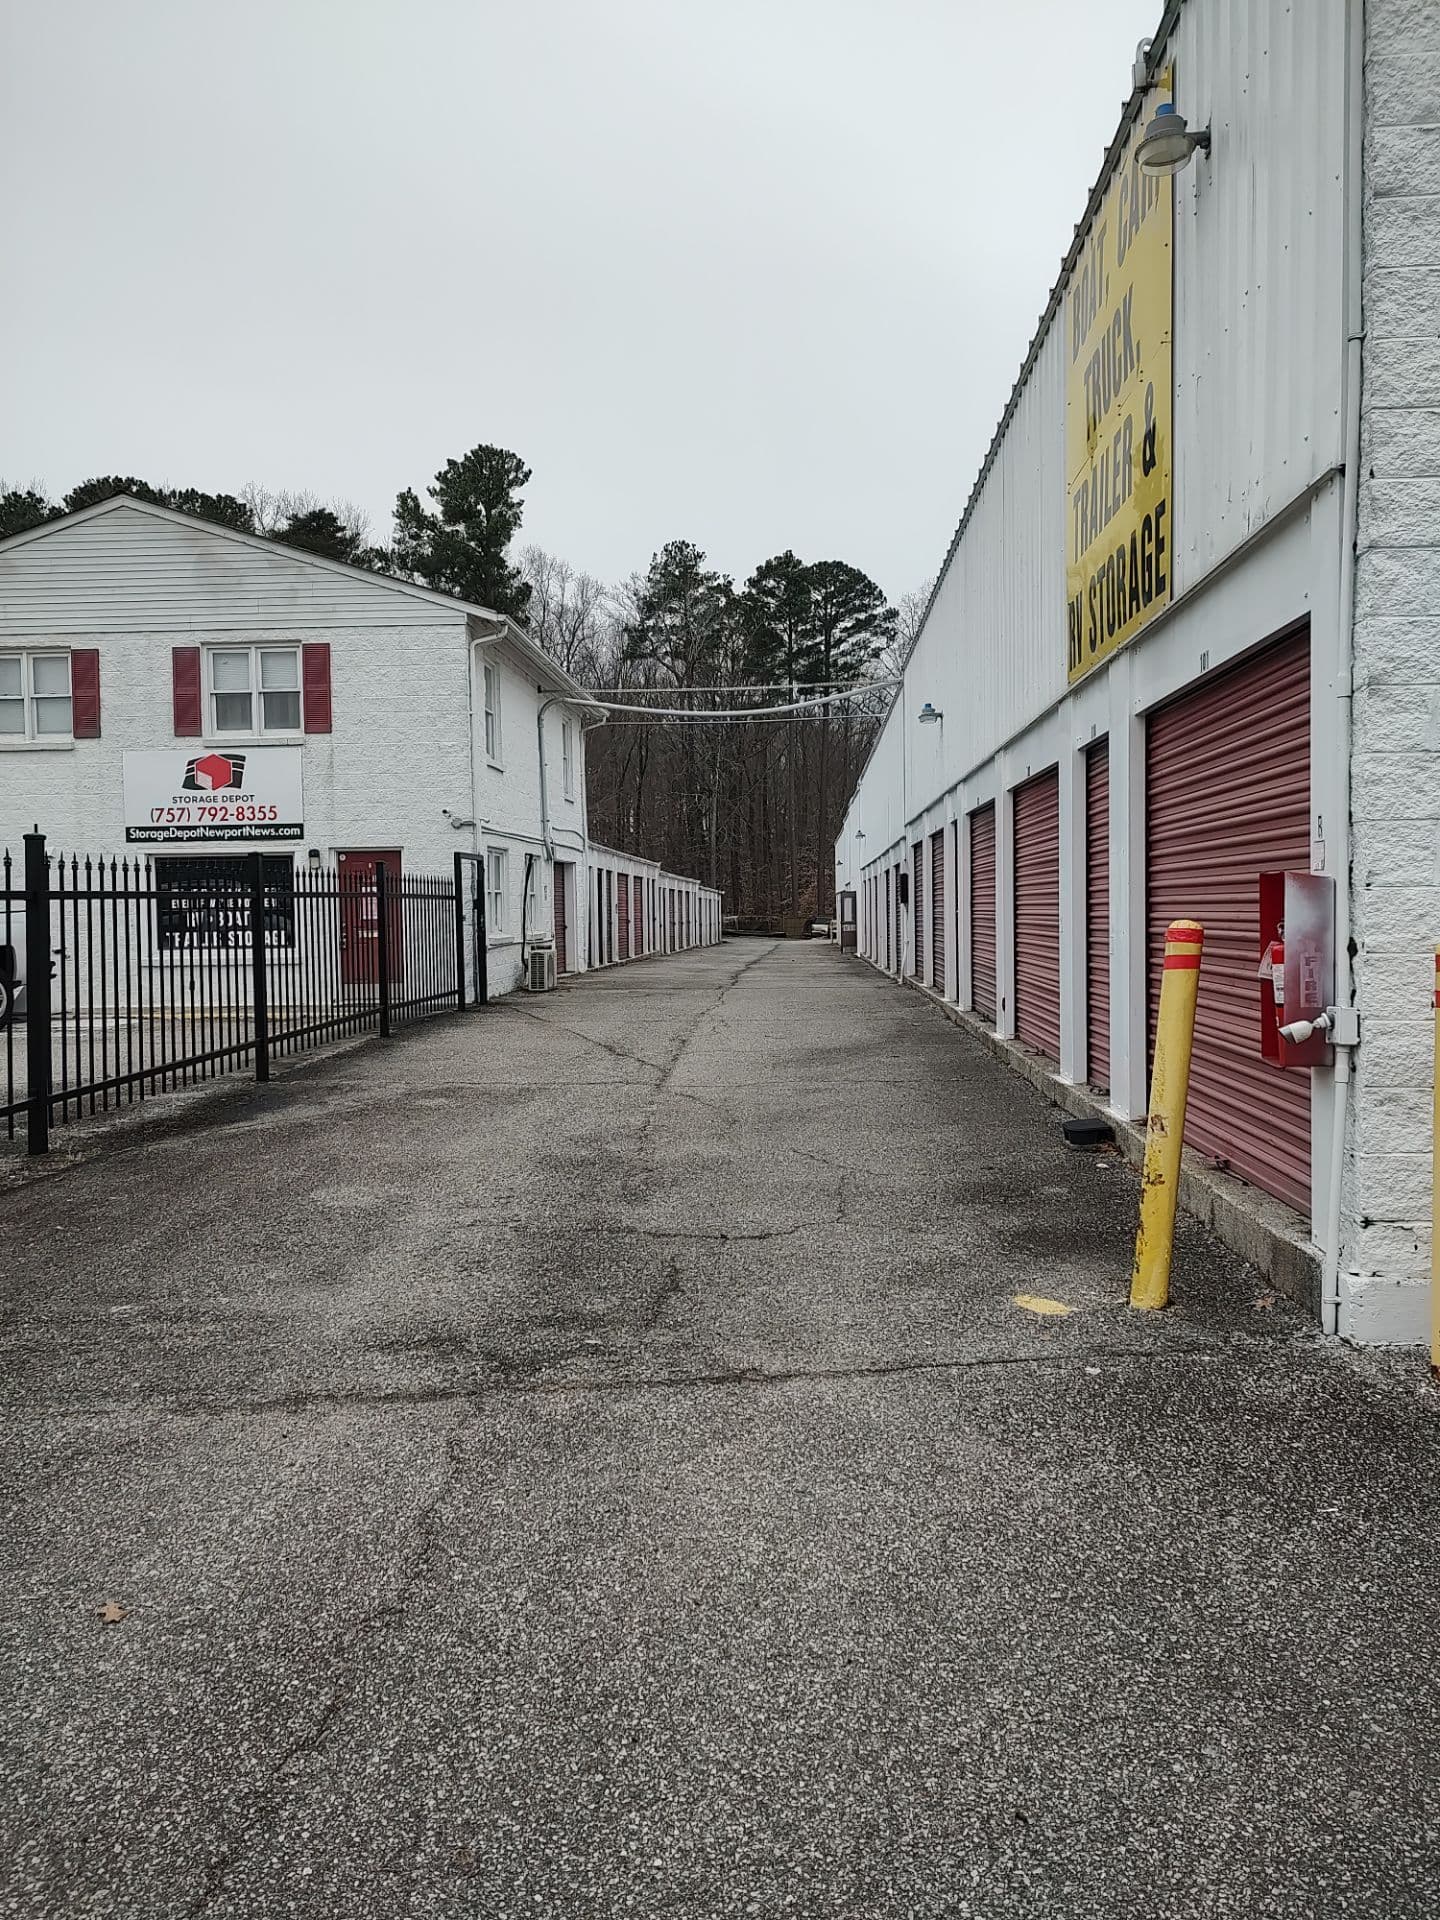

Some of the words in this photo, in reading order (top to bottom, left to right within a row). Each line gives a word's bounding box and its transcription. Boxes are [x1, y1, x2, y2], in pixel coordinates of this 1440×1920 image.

[1084, 281, 1141, 442] TRUCK,
[1073, 413, 1133, 565] TRAILER
[1142, 381, 1157, 477] &
[1069, 590, 1082, 673] RV
[1089, 498, 1166, 654] STORAGE
[150, 807, 191, 823] (757)
[197, 805, 278, 822] 792-8355
[172, 795, 219, 804] STORAGE
[222, 794, 255, 803] DEPOT
[129, 825, 301, 841] StorageDepotNewportNews.com
[227, 930, 288, 947] STOAGE
[1304, 956, 1319, 1004] FIRE
